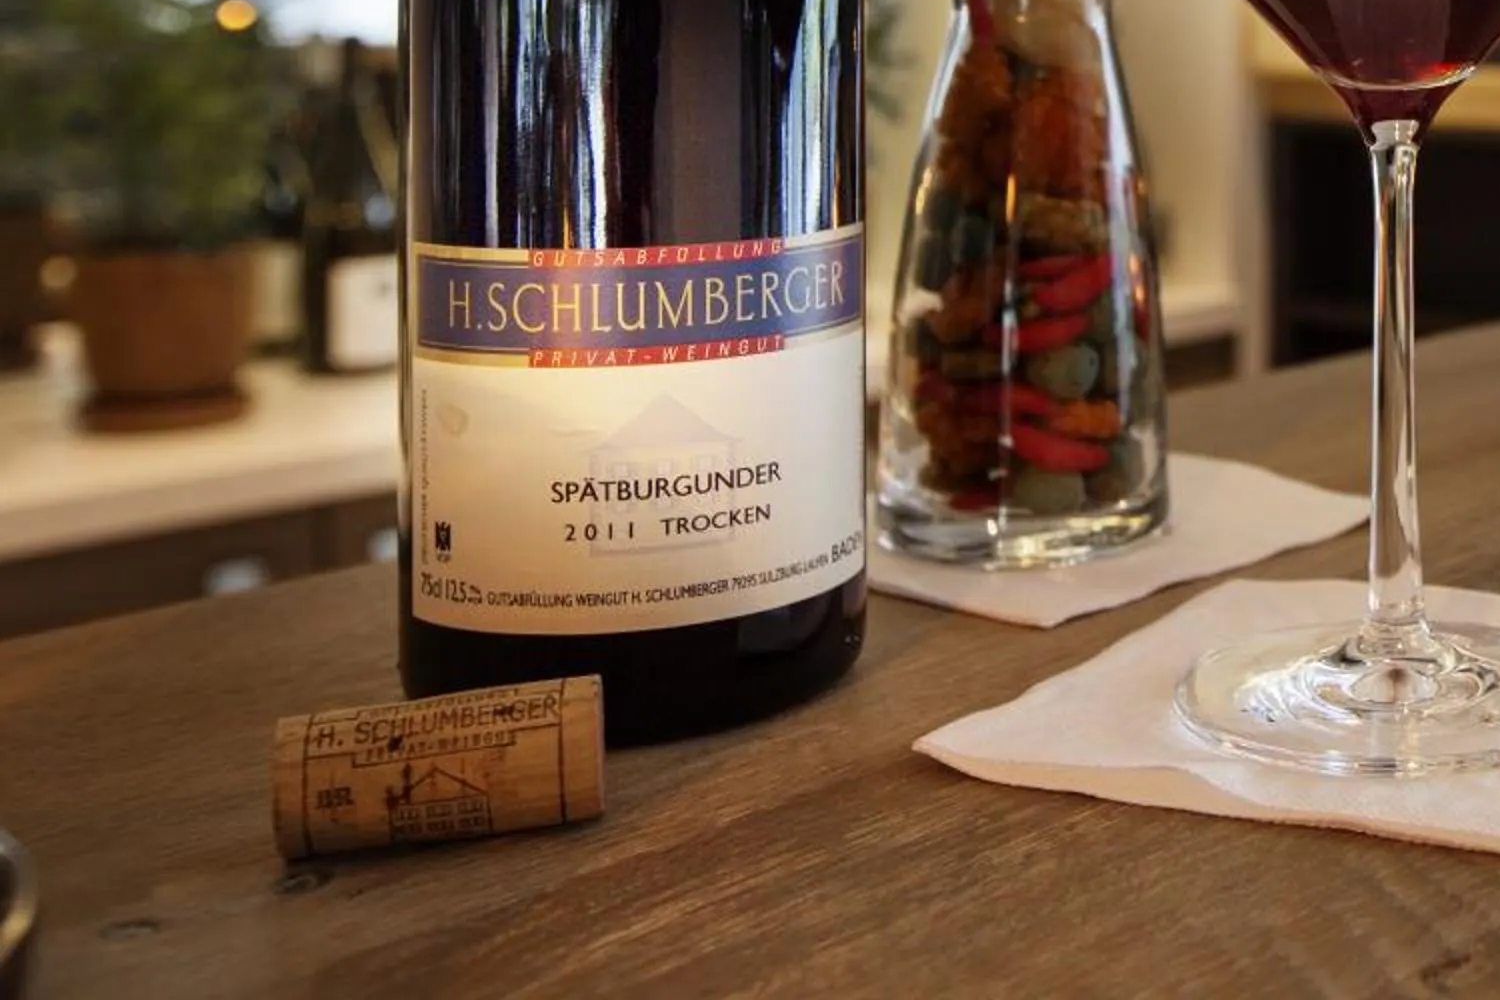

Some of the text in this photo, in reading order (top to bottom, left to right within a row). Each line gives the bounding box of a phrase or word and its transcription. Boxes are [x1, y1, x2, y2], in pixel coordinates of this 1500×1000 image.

[449, 261, 844, 334] H.SCHLUMBERGER
[533, 334, 782, 367] PRIVAT-WEINGUT
[550, 461, 783, 504] SPÄTBURGUNDER
[564, 503, 772, 542] 2011 TROCKEN
[575, 591, 627, 607] WEINGUT
[645, 578, 729, 603] SCHLUMBERGER
[354, 696, 559, 745] SCHLUMBERGER
